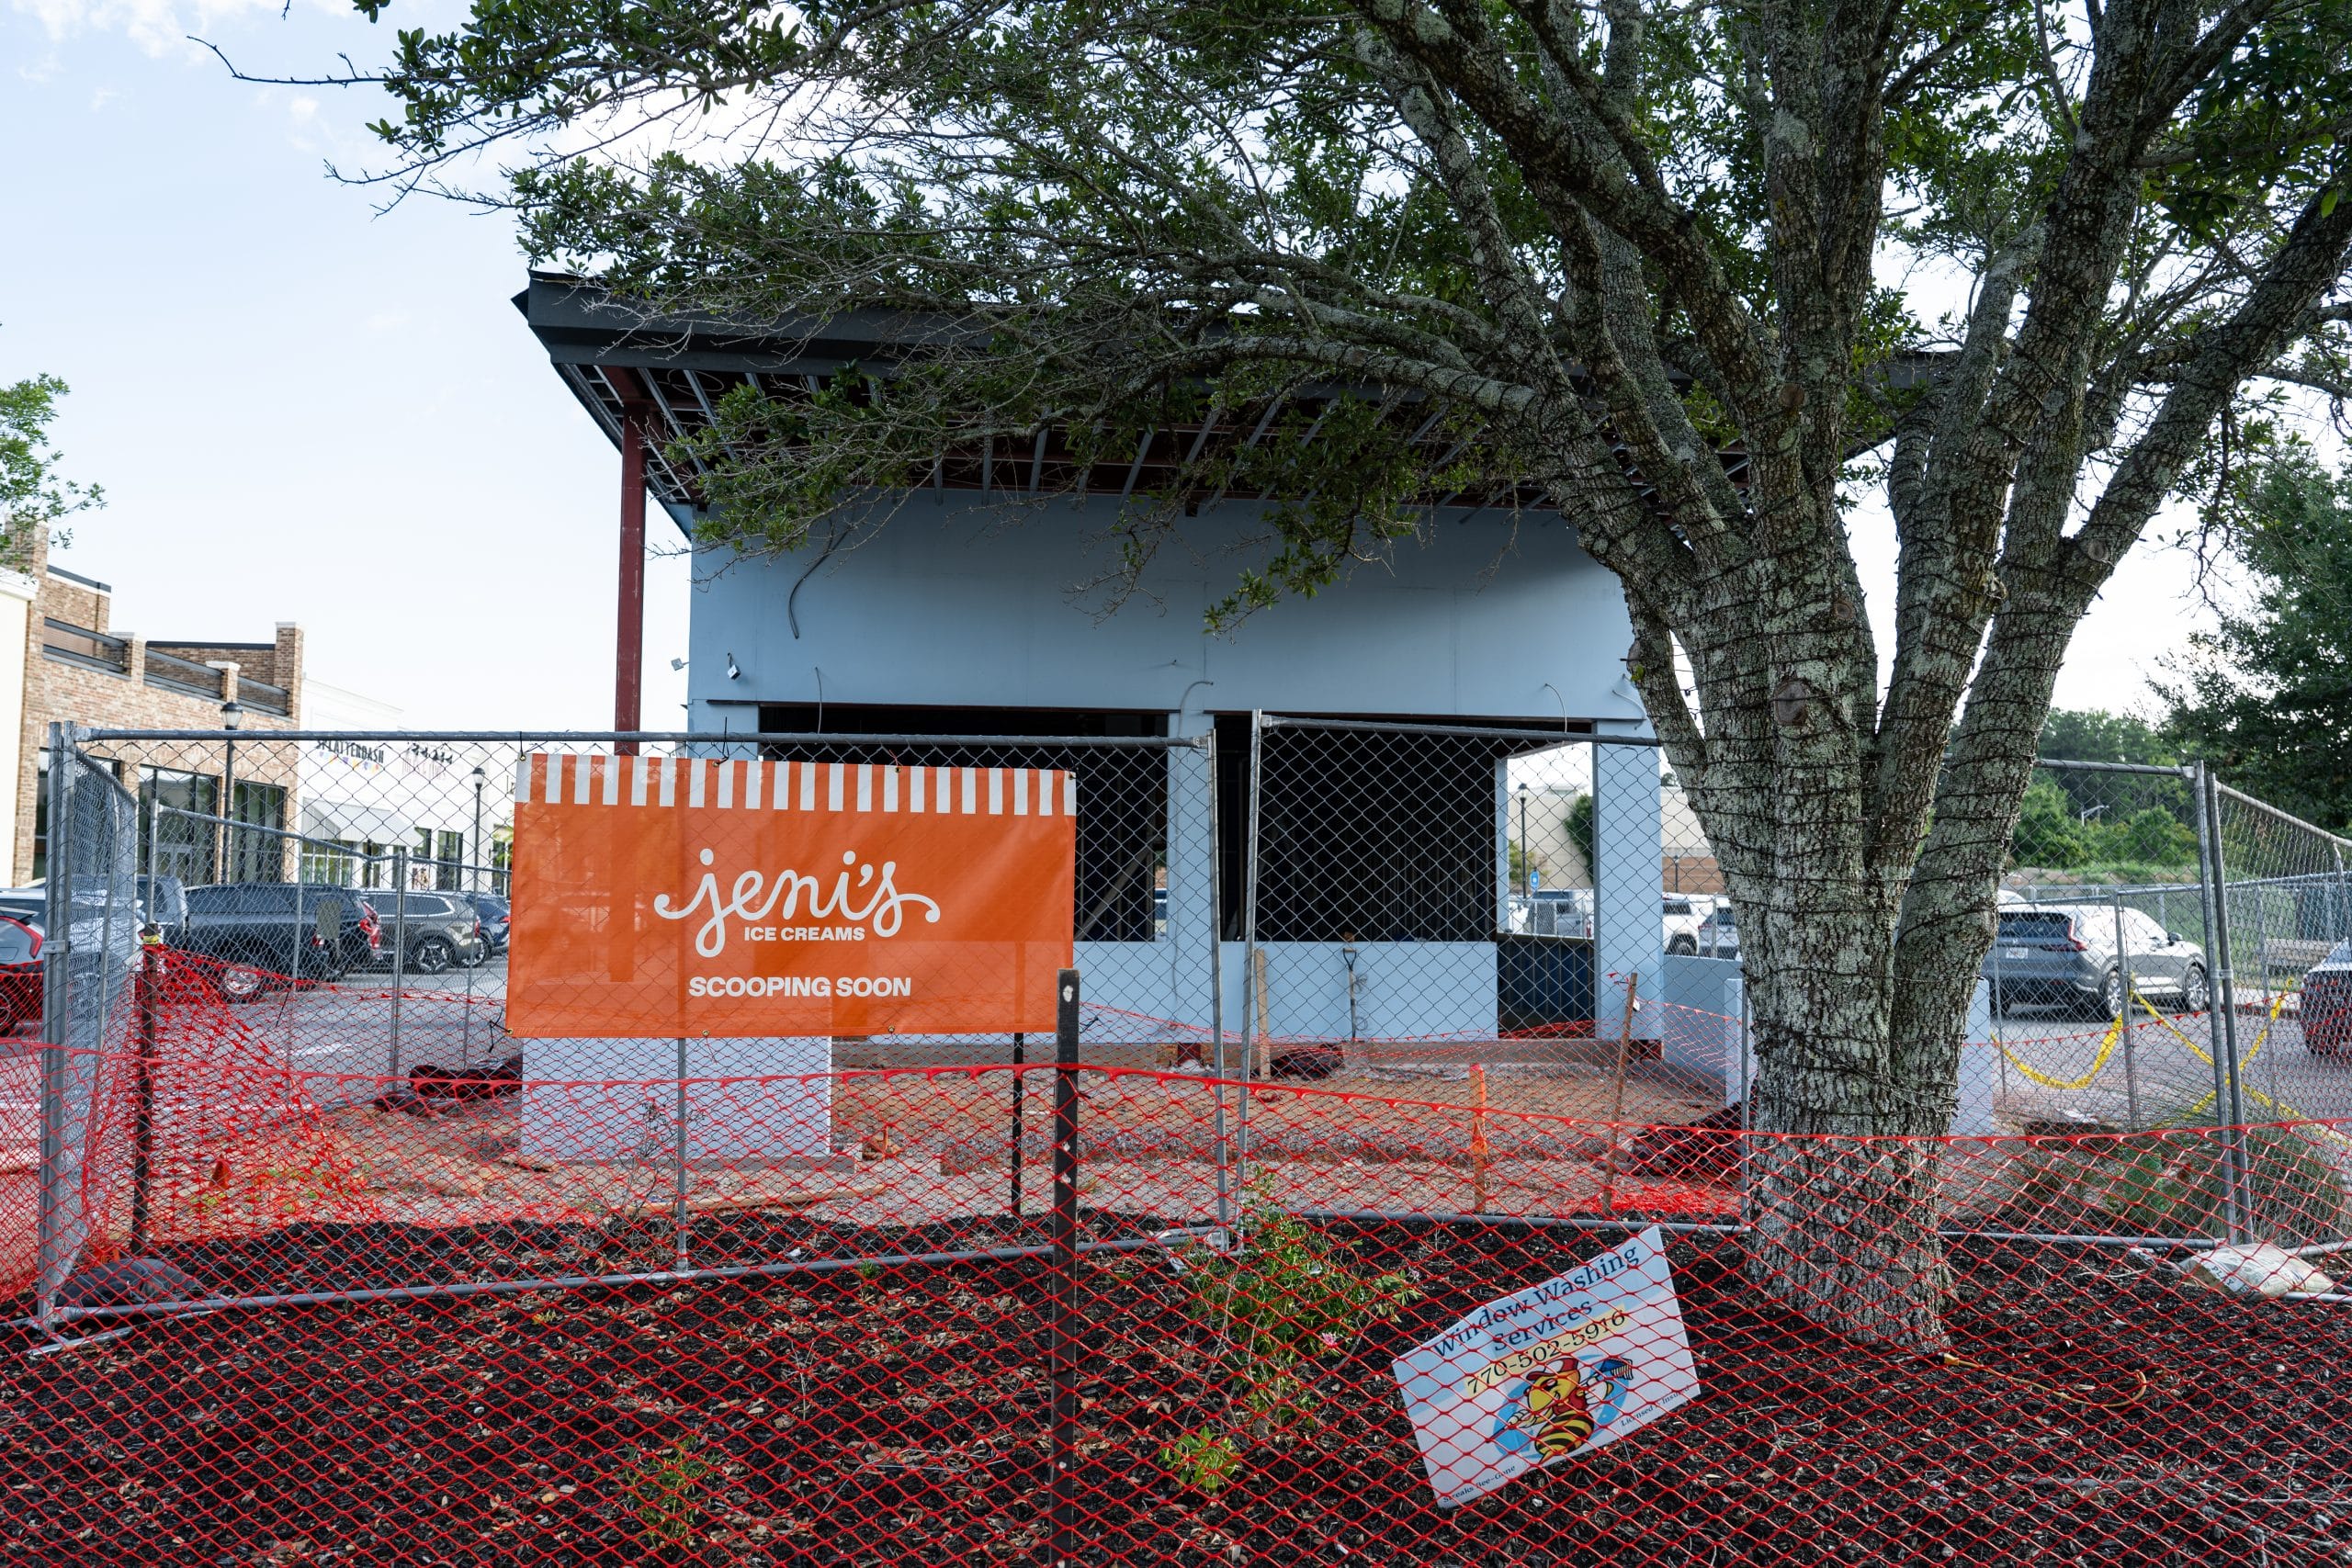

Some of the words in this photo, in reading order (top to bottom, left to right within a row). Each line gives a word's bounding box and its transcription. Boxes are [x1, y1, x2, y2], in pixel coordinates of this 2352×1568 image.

[653, 848, 941, 958] jeni's
[744, 927, 777, 942] ICE
[781, 926, 865, 942] CREAMS
[688, 976, 831, 998] SCOOPING
[835, 976, 912, 998] SOON
[1432, 1298, 1529, 1358] Window
[1532, 1246, 1640, 1305] Washing
[1493, 1301, 1593, 1352] Services
[1467, 1308, 1626, 1394] 770-502-5916
[1621, 1404, 1655, 1427] Licnsed
[1661, 1384, 1690, 1404] Insud
[1443, 1486, 1475, 1503] Sreaks
